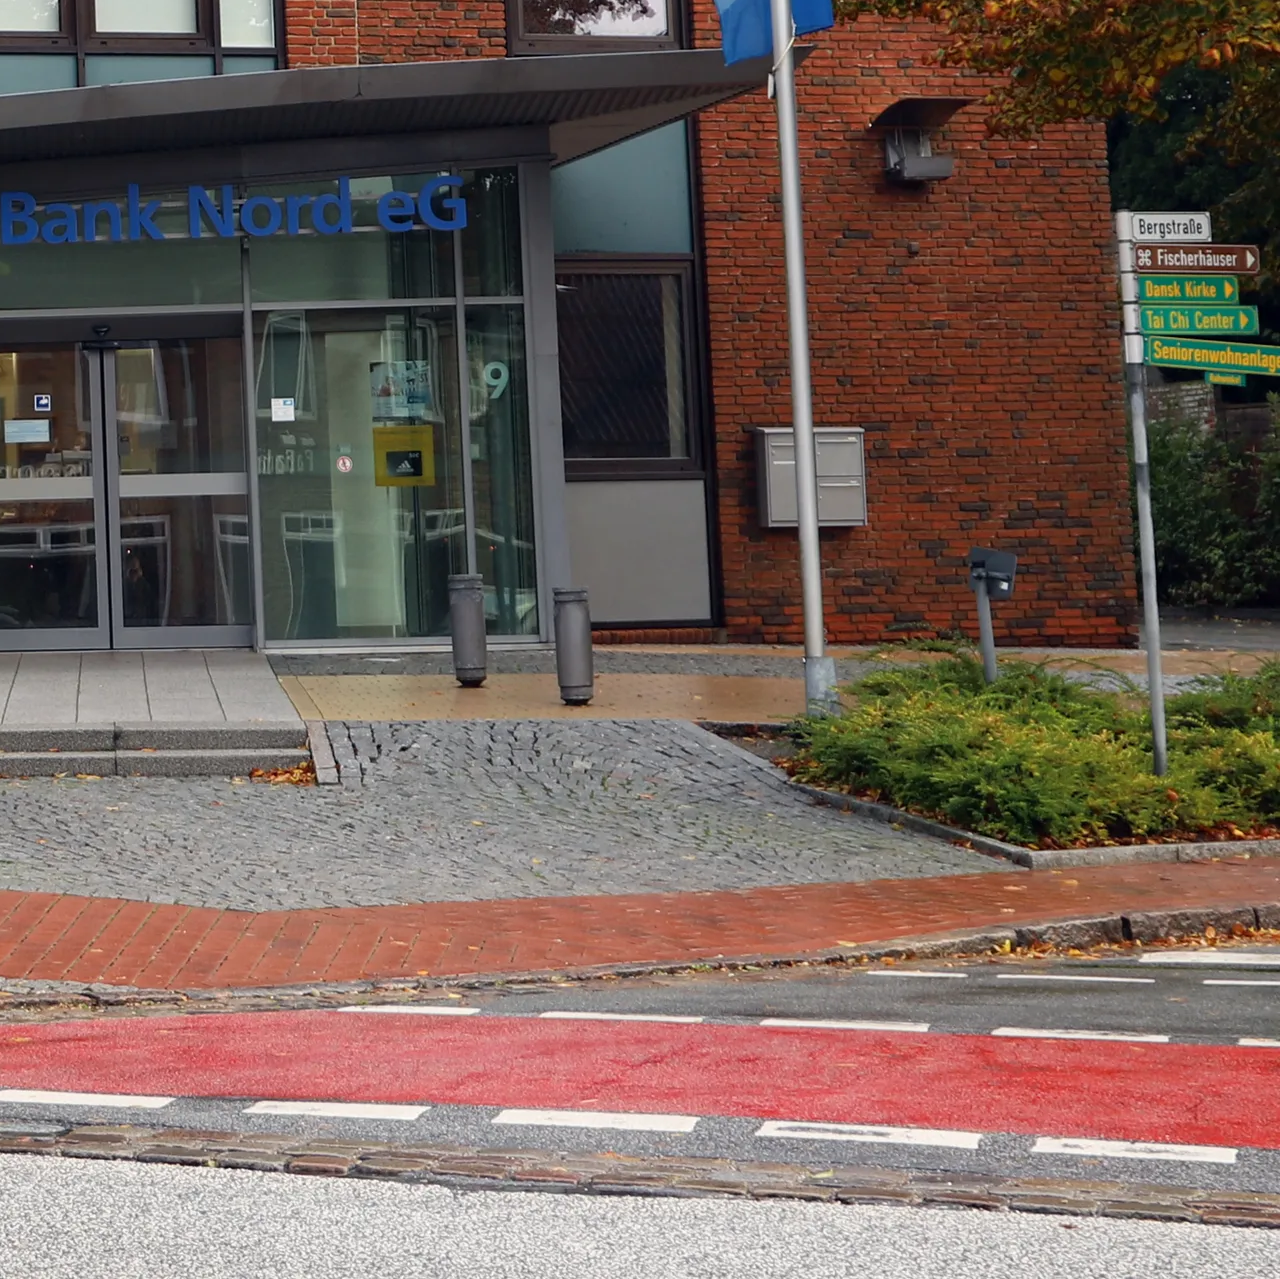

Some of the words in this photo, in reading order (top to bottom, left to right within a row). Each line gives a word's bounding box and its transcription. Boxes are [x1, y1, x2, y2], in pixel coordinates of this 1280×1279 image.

[188, 175, 351, 238] Nord
[376, 175, 468, 232] eG
[1138, 218, 1203, 238] Bergstraße
[1157, 249, 1238, 267] Fischerhäuser
[1145, 280, 1181, 297] Dansk
[1185, 281, 1217, 297] Kirke
[1146, 310, 1165, 329] Tai
[1169, 310, 1190, 329] Chi
[1194, 311, 1235, 329] Center
[483, 361, 510, 400] 9
